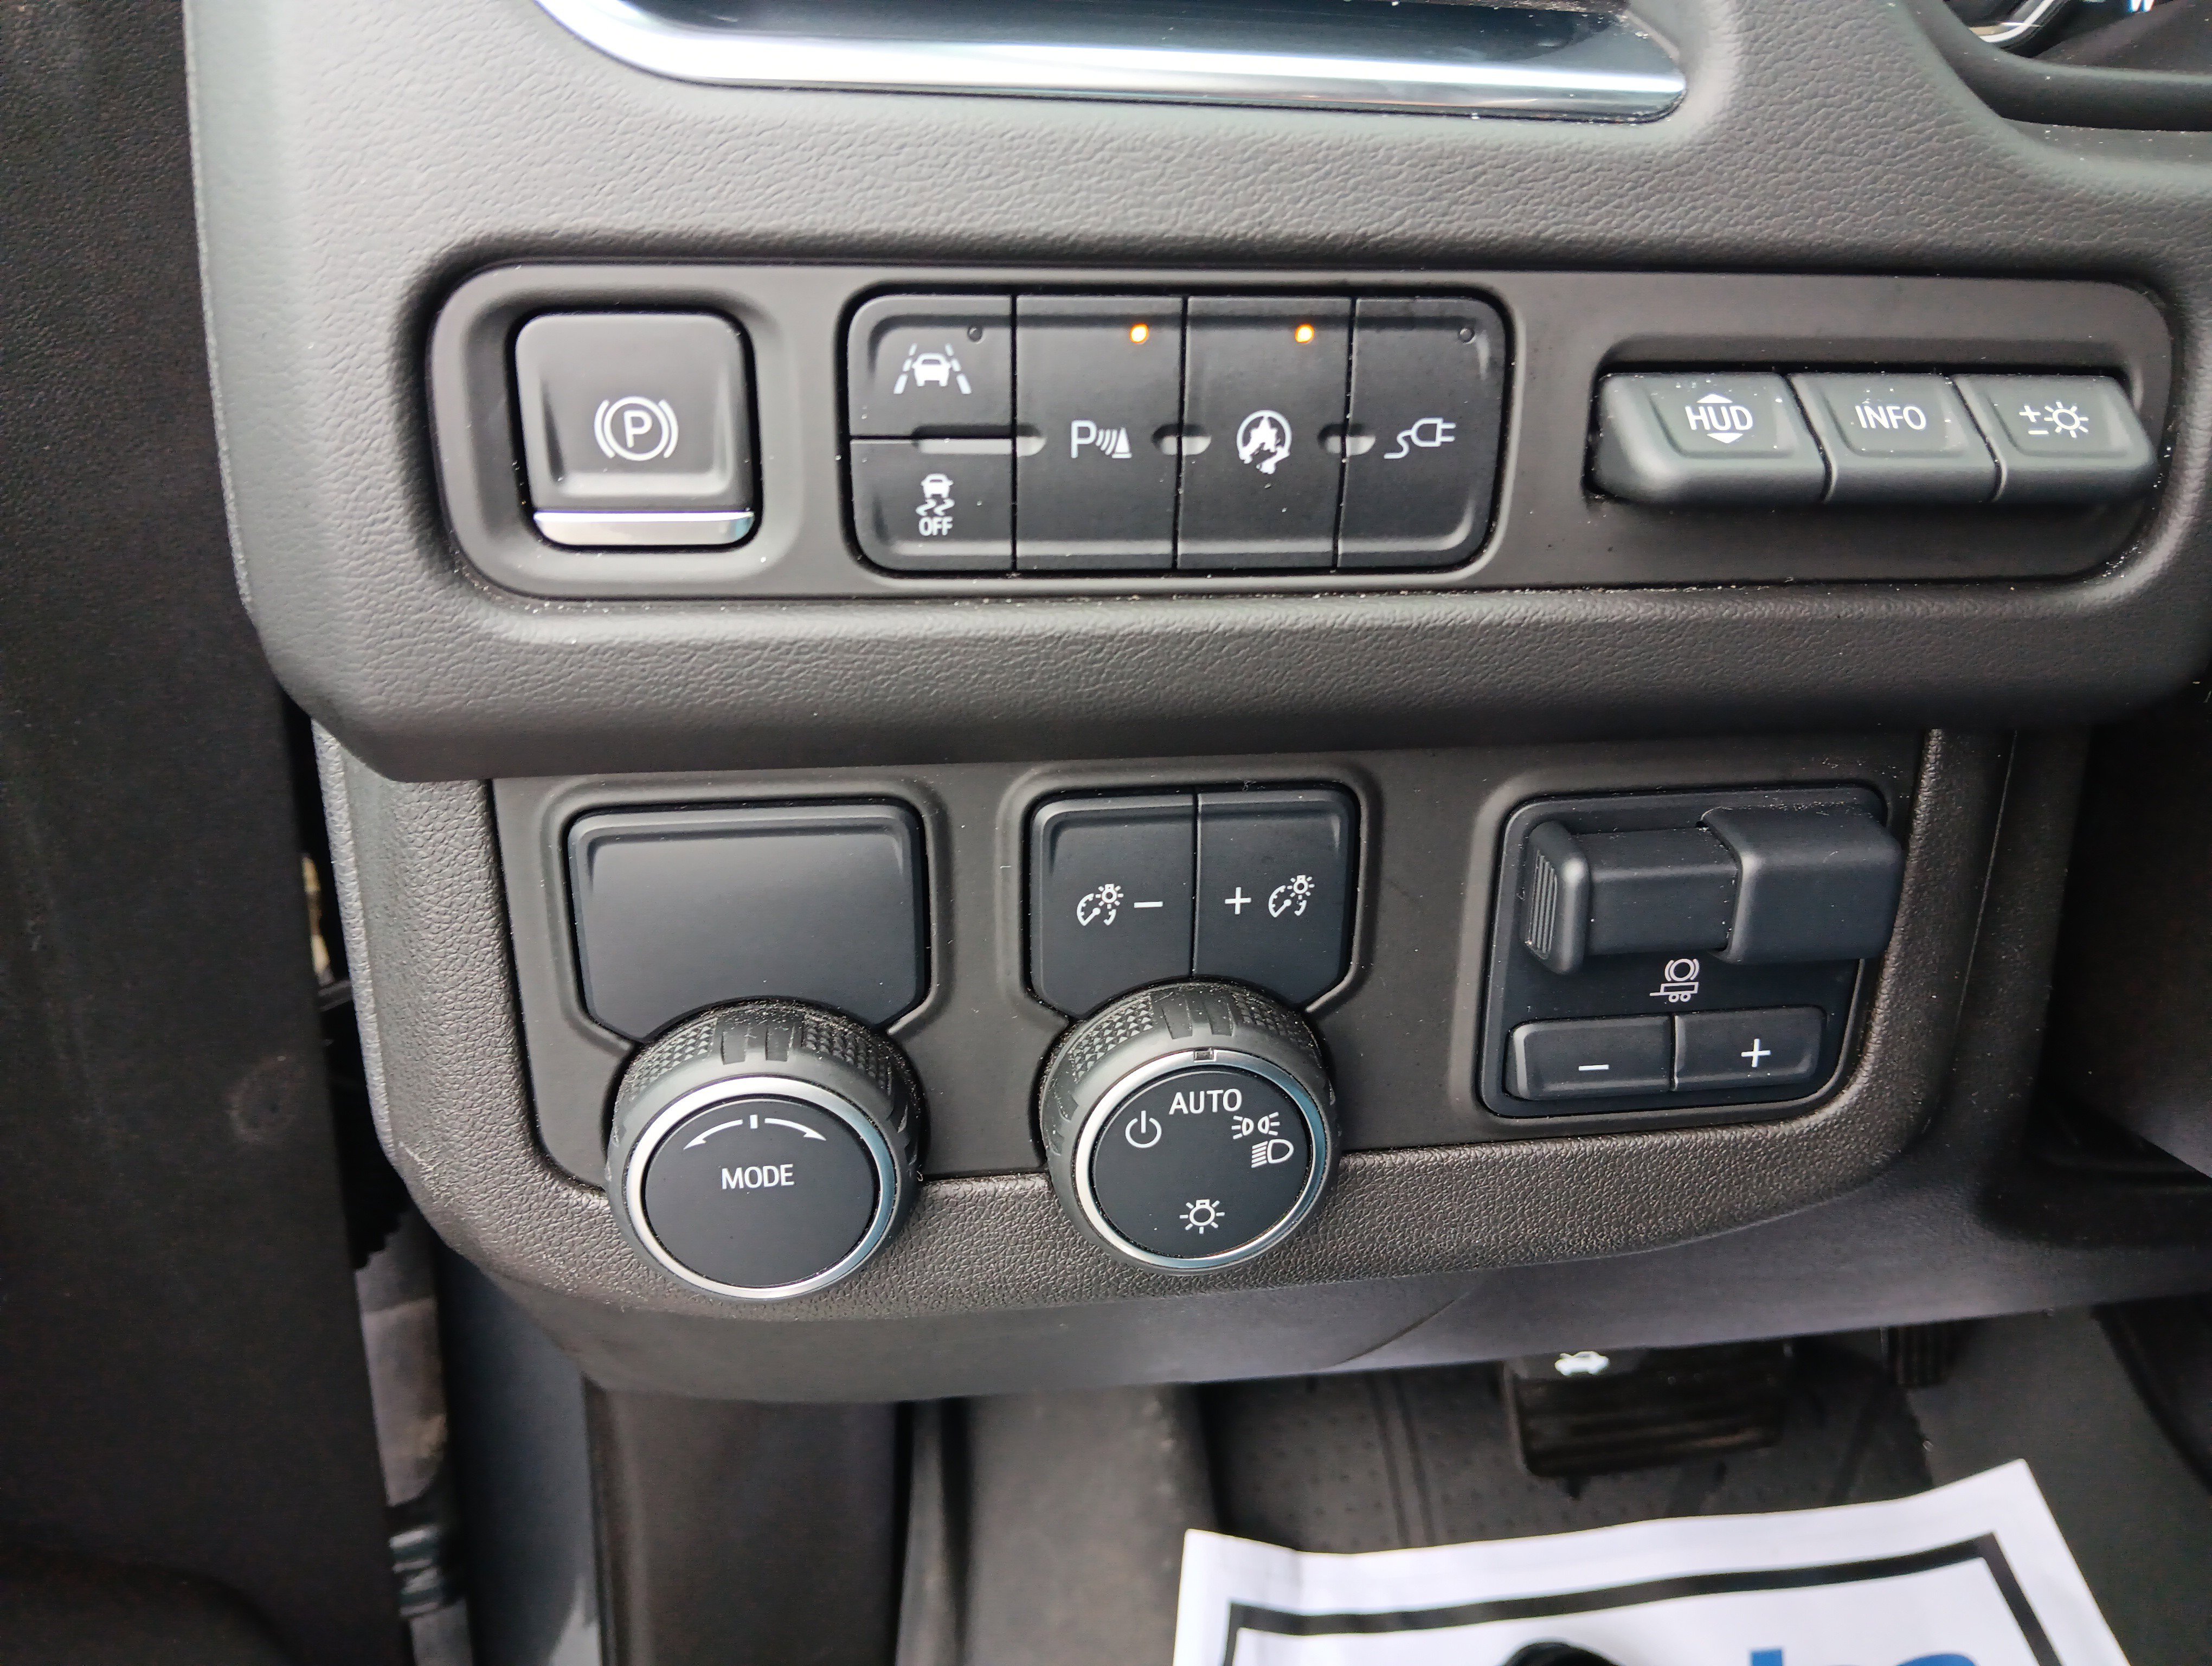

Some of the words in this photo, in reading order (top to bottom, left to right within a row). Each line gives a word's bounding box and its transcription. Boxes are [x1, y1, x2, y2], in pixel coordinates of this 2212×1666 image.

[1684, 405, 1754, 431] HUD
[1854, 405, 1927, 431] INFO
[918, 516, 954, 536] OFF
[1168, 1088, 1243, 1116] AUTO
[721, 1163, 795, 1190] MODE
